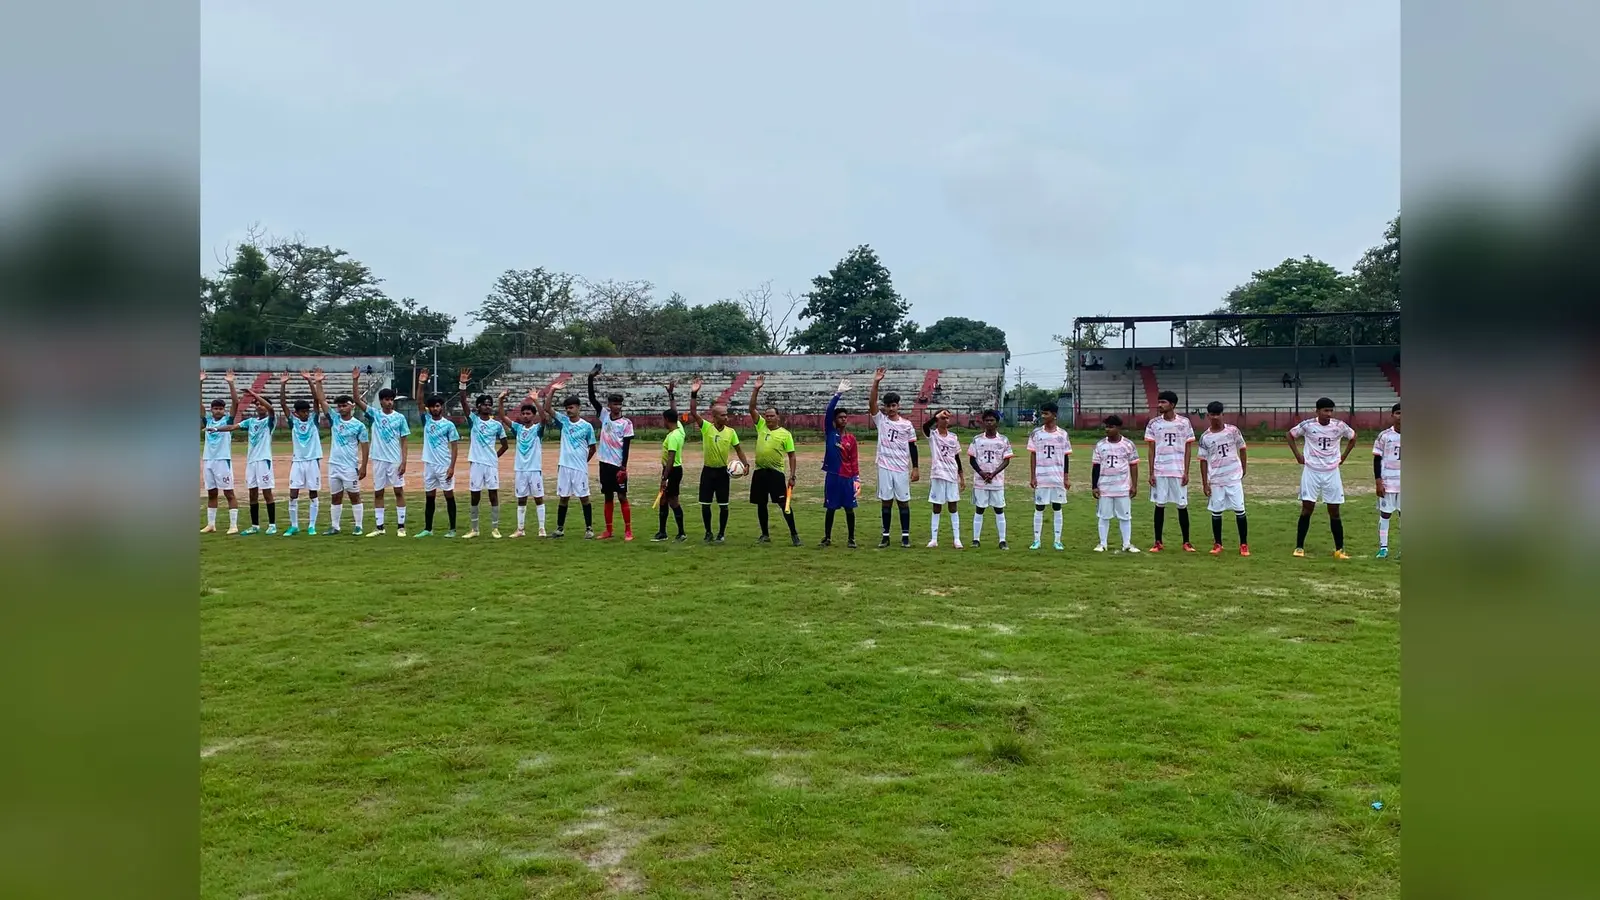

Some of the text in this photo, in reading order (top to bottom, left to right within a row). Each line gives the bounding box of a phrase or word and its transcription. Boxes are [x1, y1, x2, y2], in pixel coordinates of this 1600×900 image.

[888, 429, 899, 442] T
[1164, 433, 1176, 446] T
[1218, 443, 1229, 457] T
[1319, 437, 1331, 450] T
[984, 450, 995, 463] T
[1044, 445, 1055, 458] T
[1107, 455, 1118, 468] T
